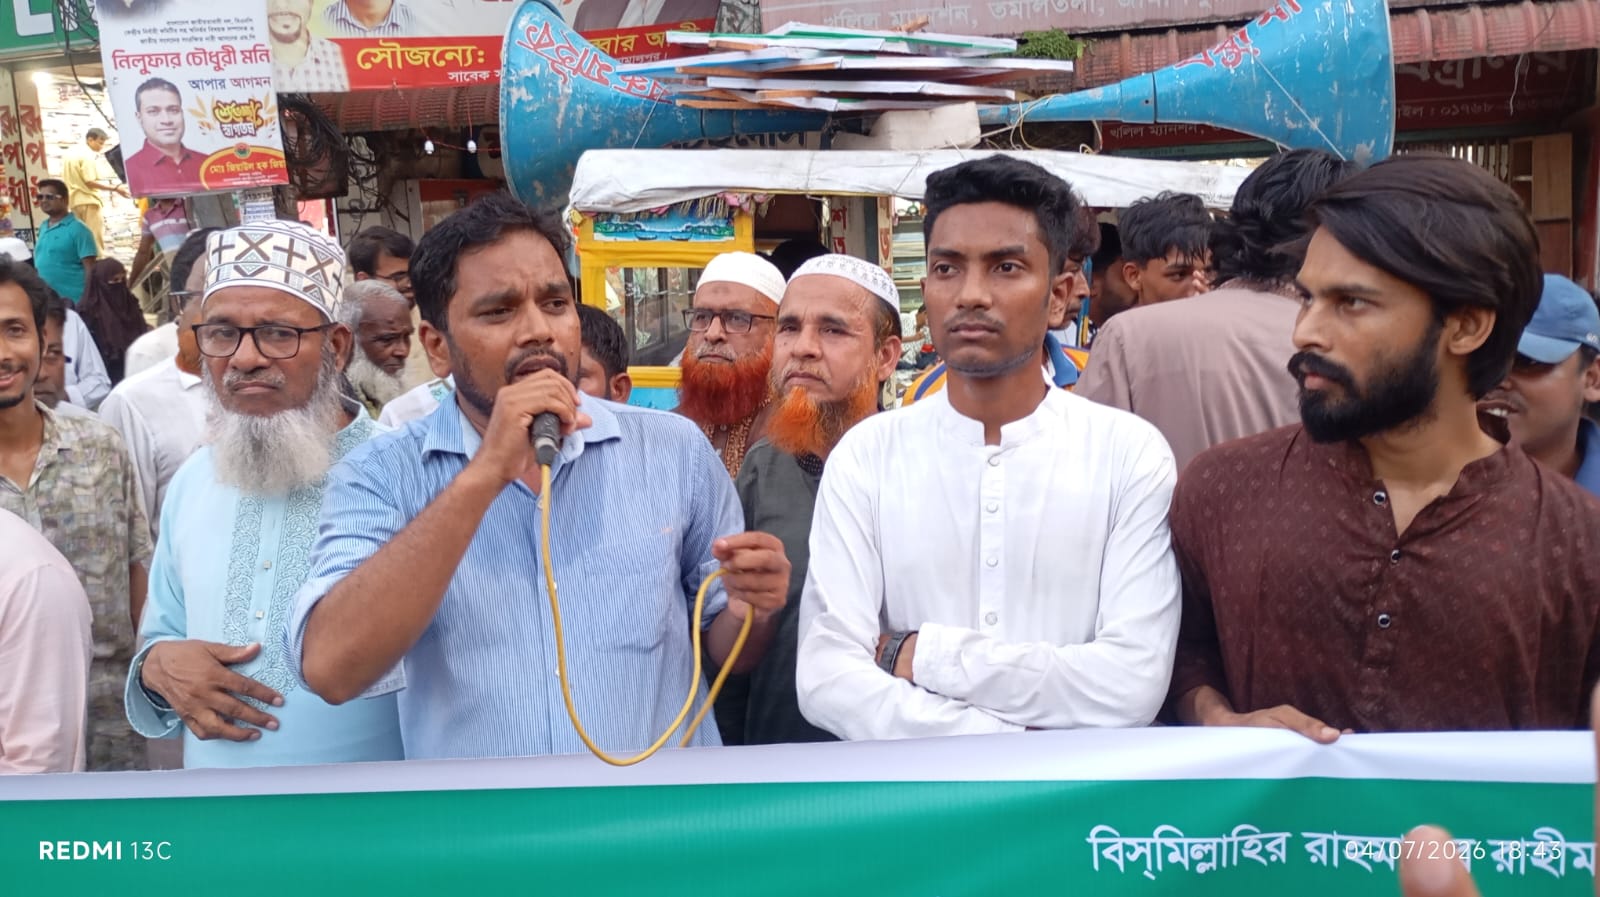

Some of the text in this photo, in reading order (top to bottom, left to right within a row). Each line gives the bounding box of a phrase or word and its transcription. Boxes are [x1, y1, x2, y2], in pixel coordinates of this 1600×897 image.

[112, 44, 271, 75] নিলুফার চৌধুরী মনি
[447, 69, 491, 82] সাবেক
[188, 76, 272, 91] আপার আগমন
